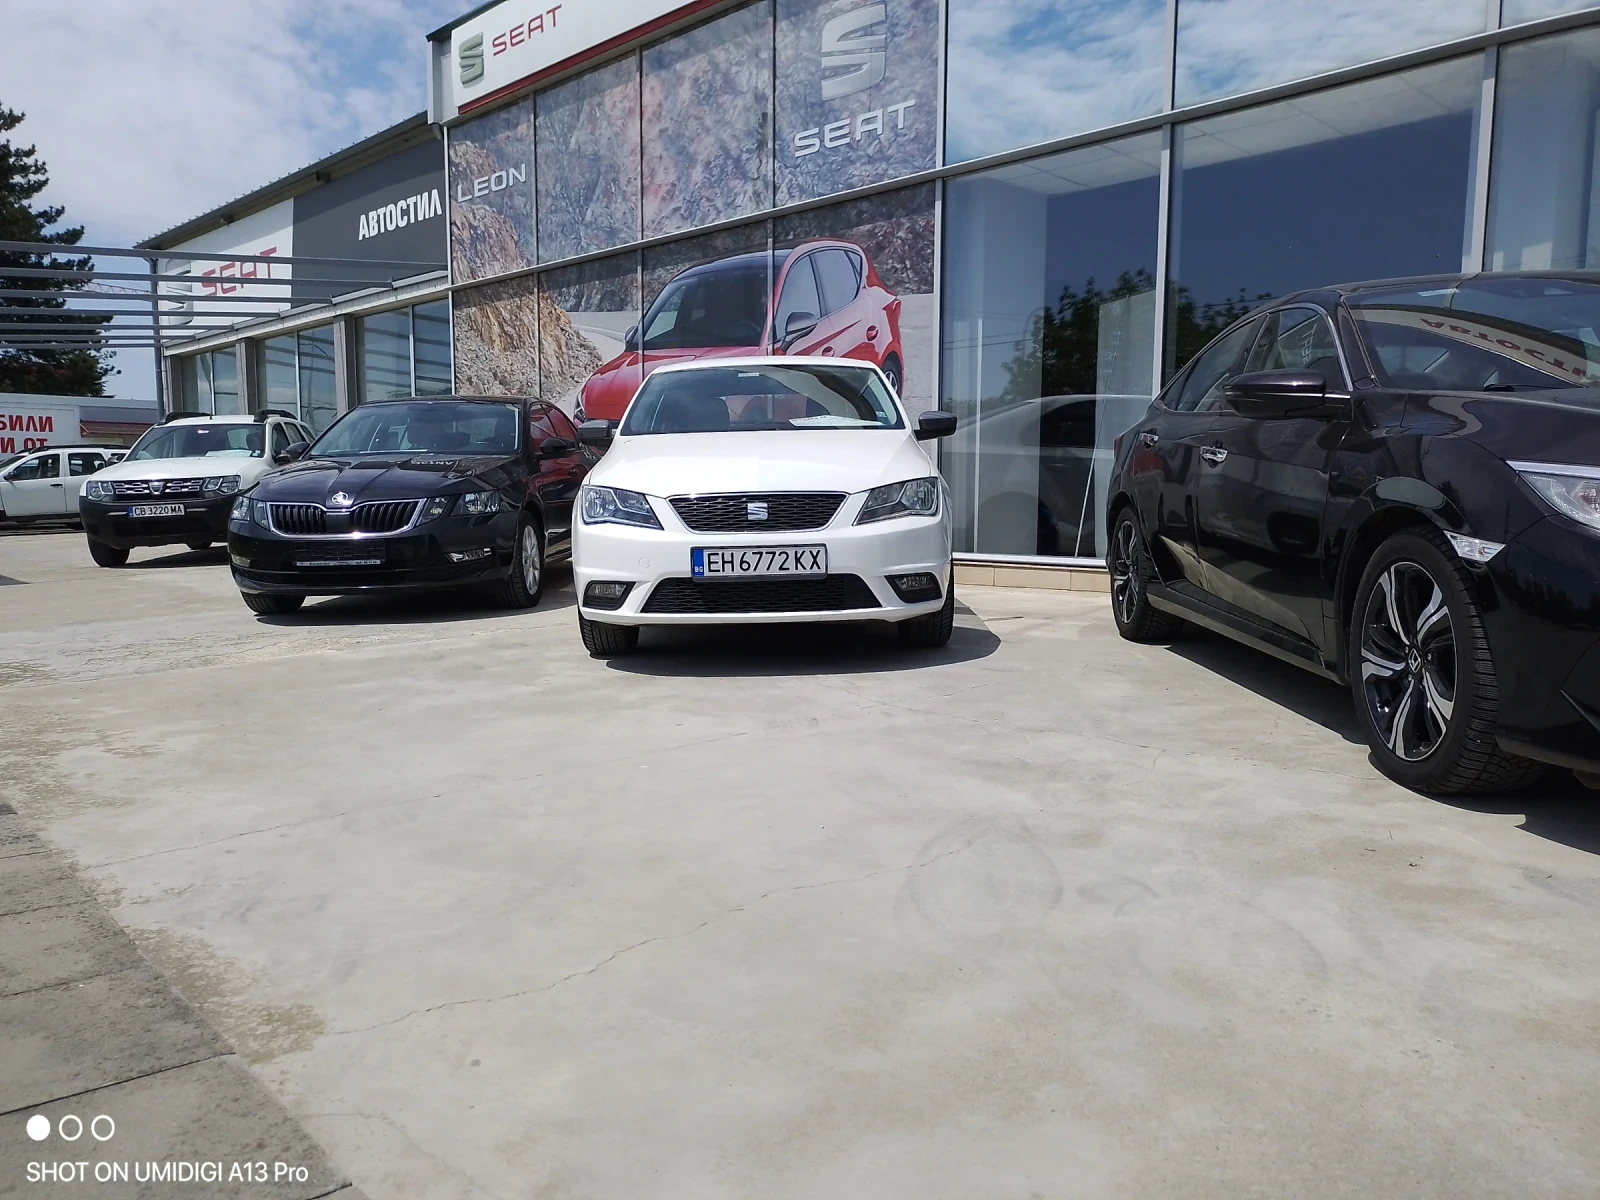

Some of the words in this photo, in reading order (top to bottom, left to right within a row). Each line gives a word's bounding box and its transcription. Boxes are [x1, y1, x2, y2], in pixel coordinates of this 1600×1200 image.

[491, 4, 562, 57] SEAT
[793, 99, 916, 158] SEAT
[457, 164, 527, 203] LEON
[358, 188, 443, 241] АВТОСТИЛ
